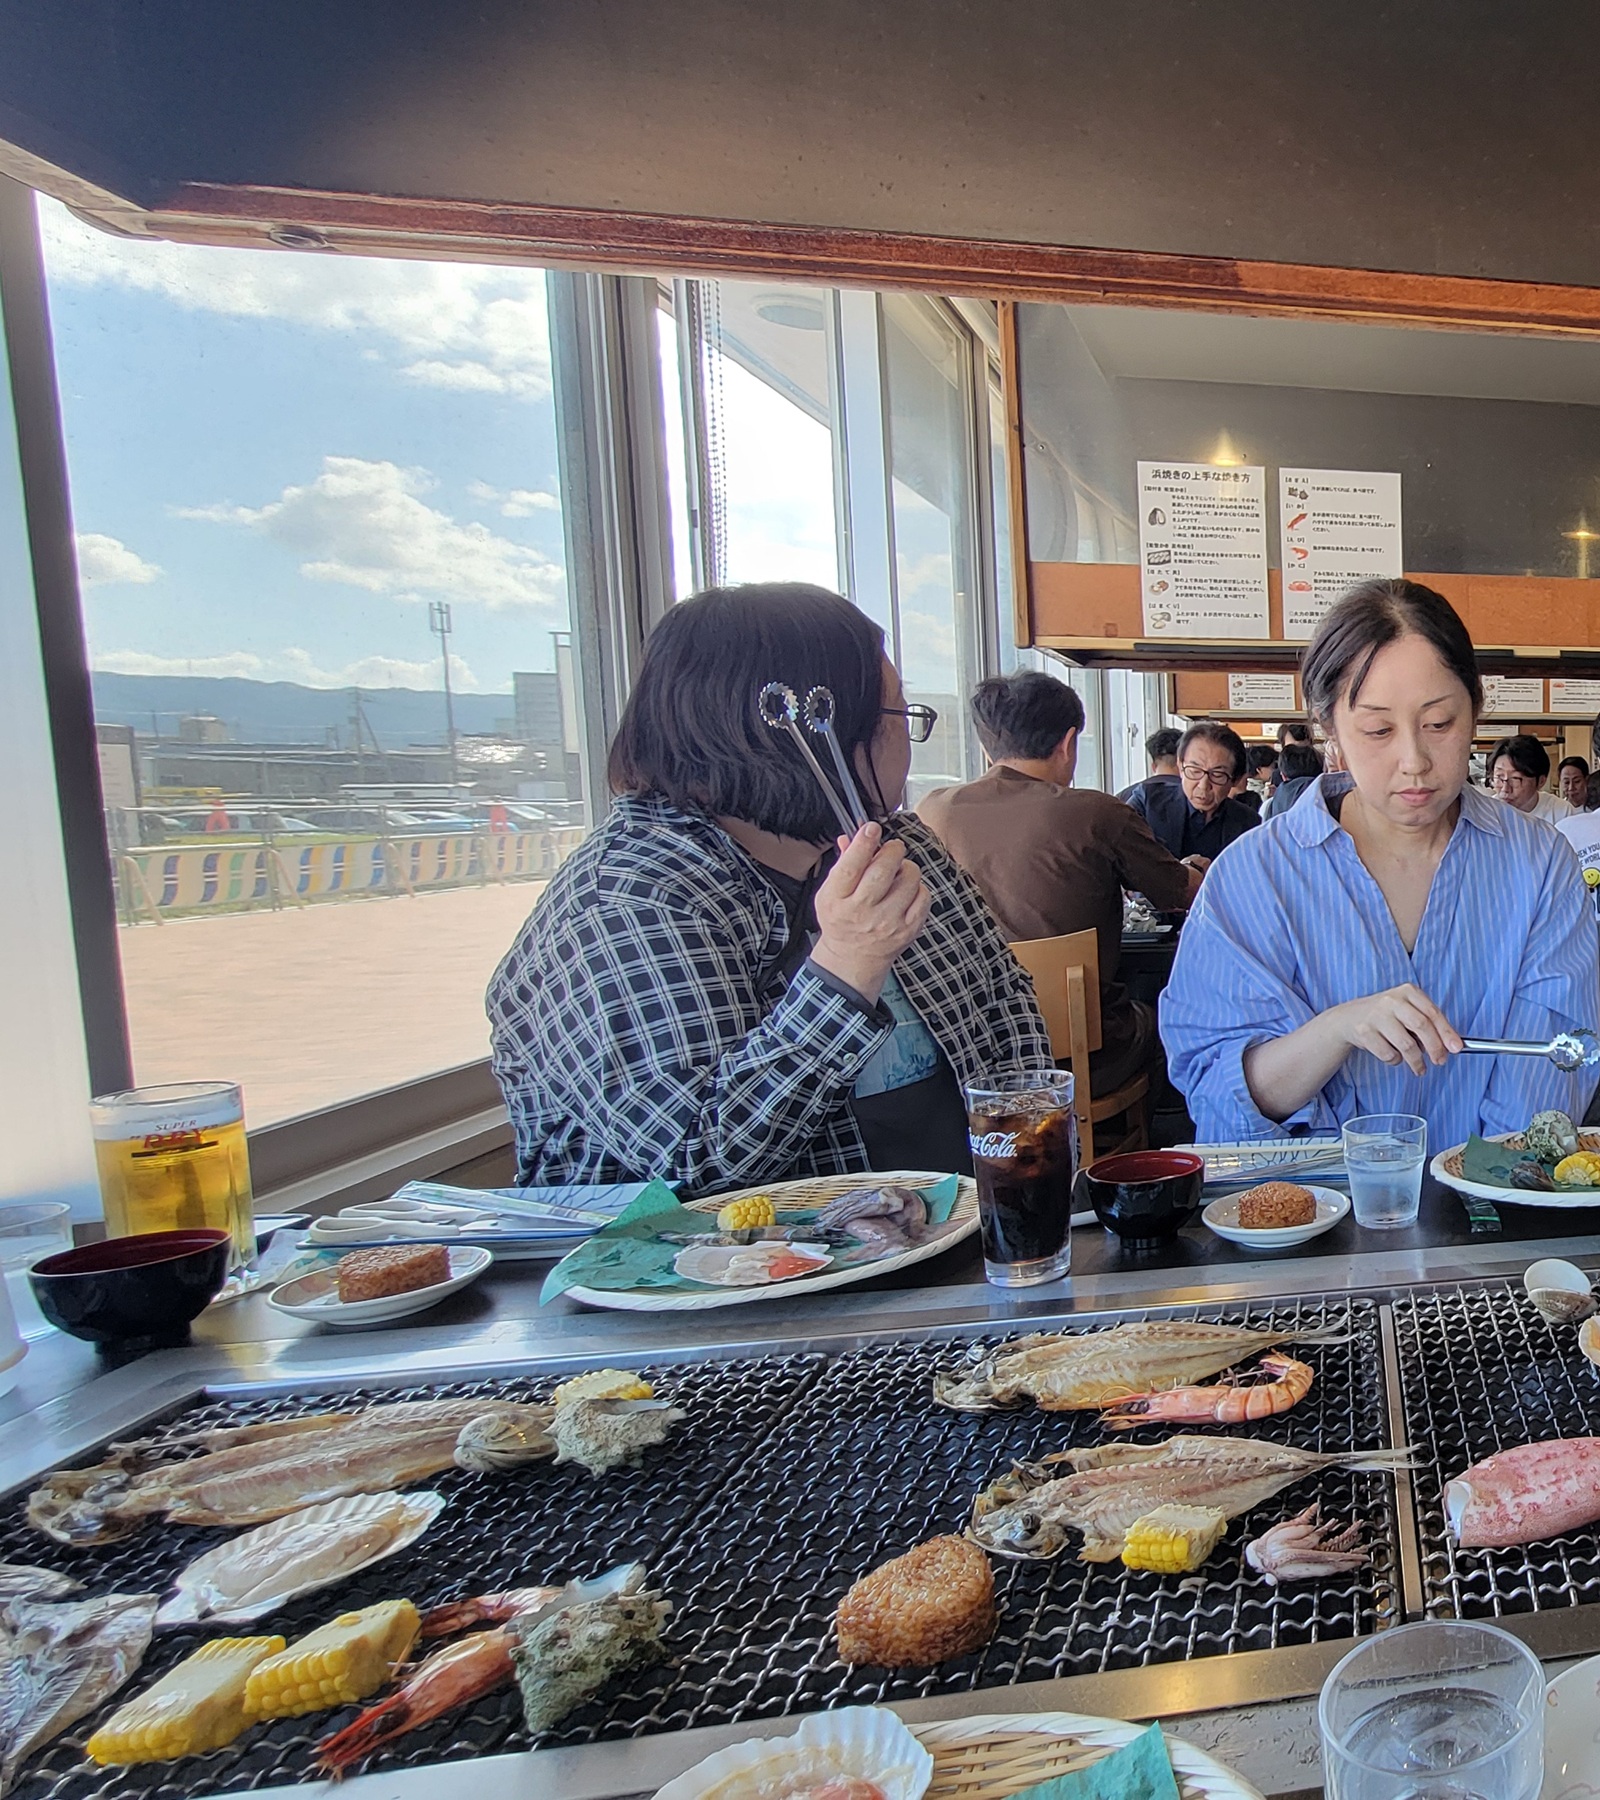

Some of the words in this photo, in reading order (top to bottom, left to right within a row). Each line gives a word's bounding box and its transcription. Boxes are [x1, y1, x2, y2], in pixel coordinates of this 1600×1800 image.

[1151, 469, 1251, 483] 浜焼きの上手な焼き方
[1588, 843, 1600, 854] YOU
[155, 1119, 197, 1131] SUPER
